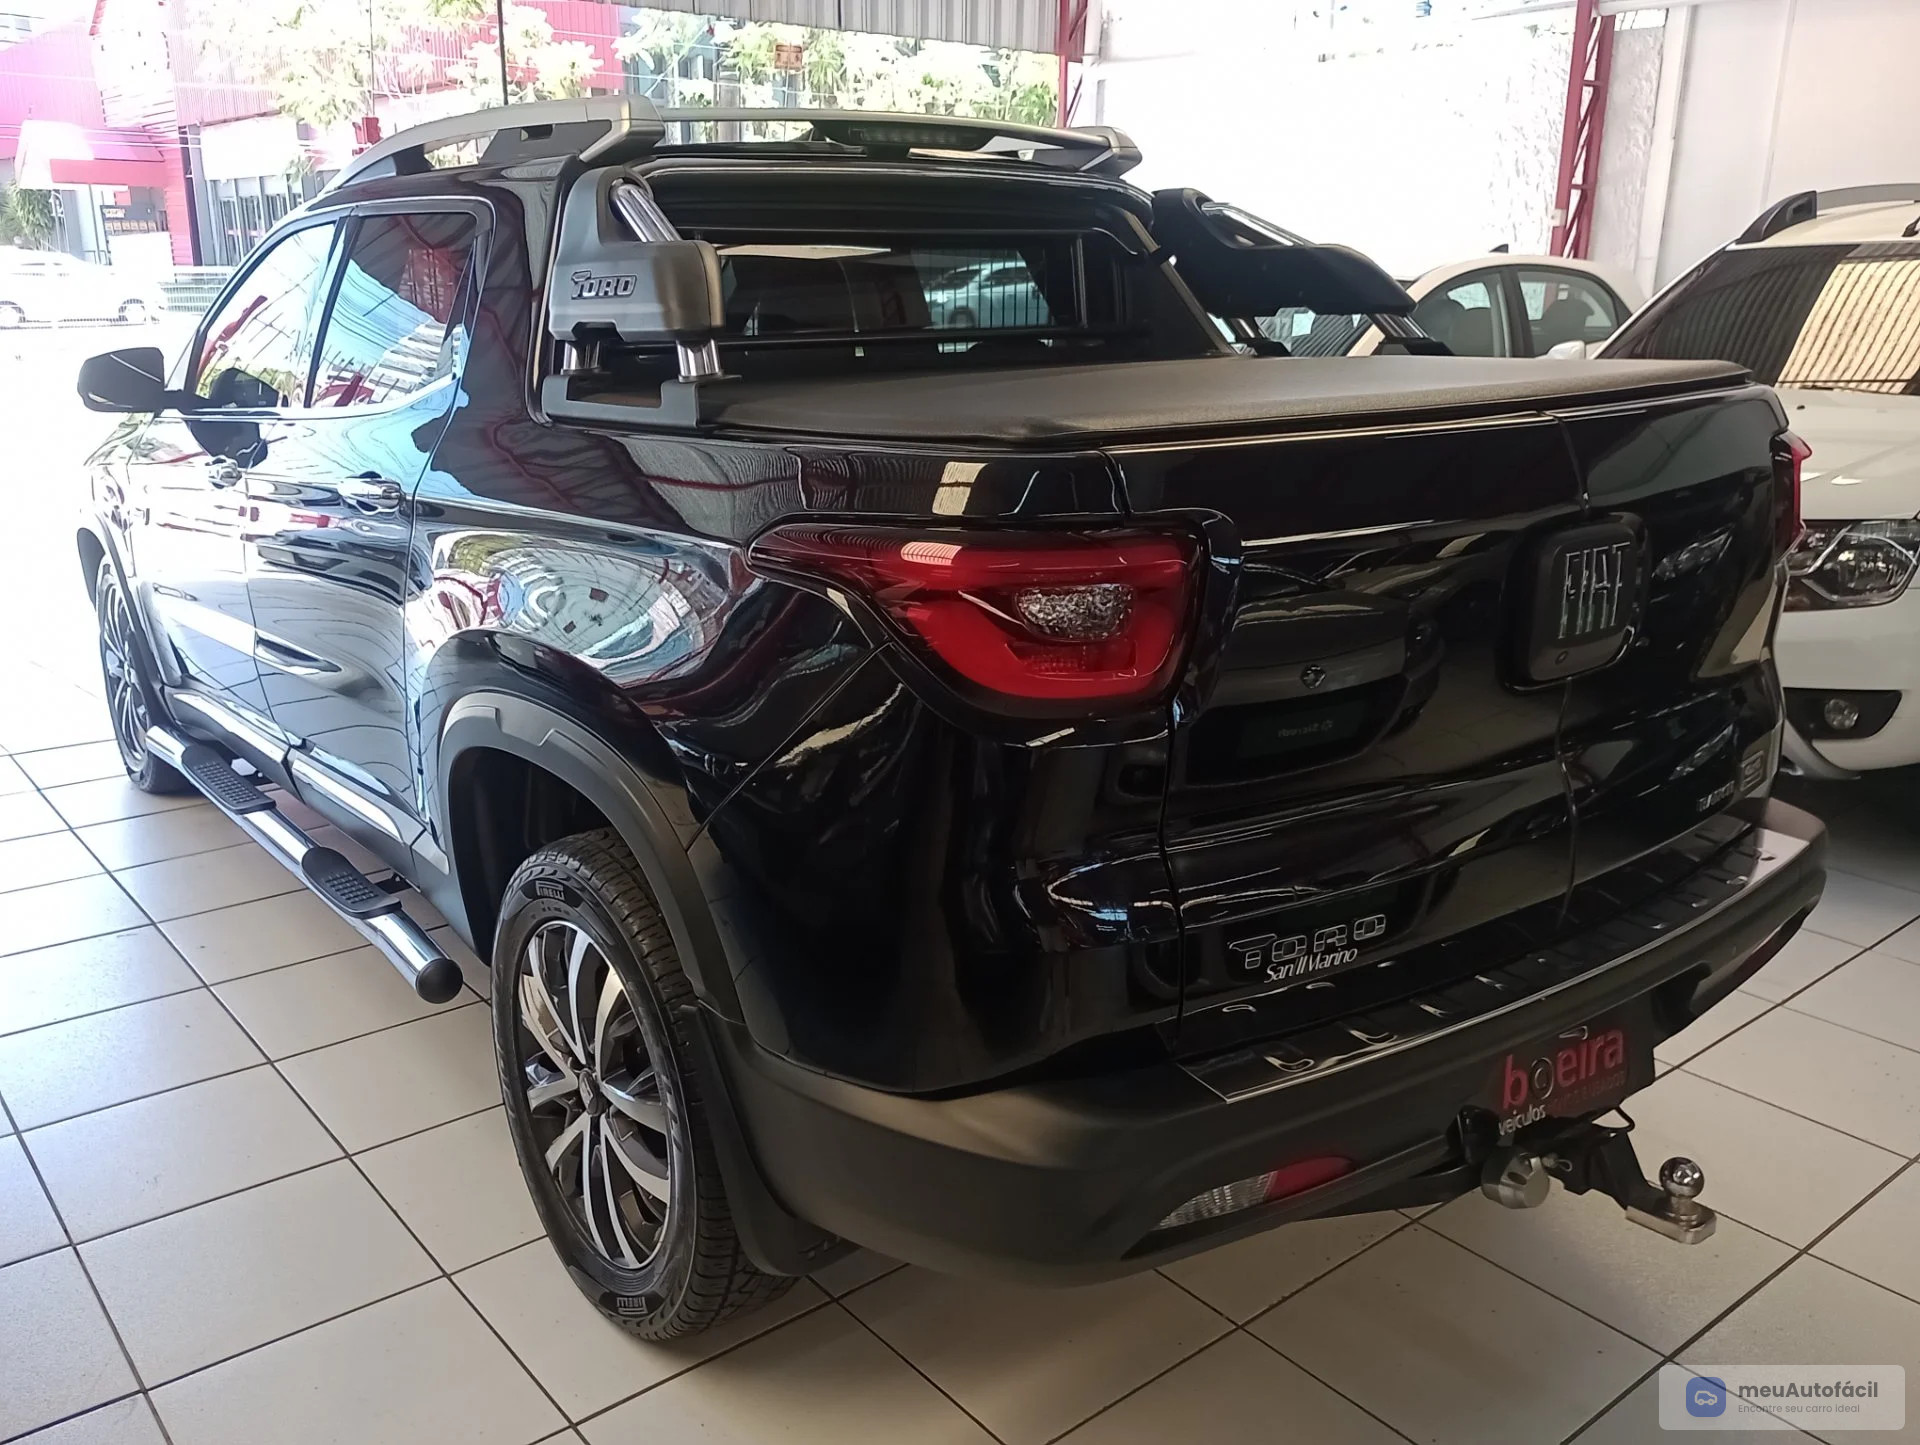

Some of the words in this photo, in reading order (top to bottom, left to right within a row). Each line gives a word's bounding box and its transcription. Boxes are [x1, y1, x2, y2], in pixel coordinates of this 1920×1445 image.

[571, 269, 637, 300] TORO
[1558, 541, 1630, 639] FIAT
[535, 880, 565, 901] PIRELLI
[1228, 914, 1387, 970] TORO
[1503, 1029, 1624, 1110] boeira
